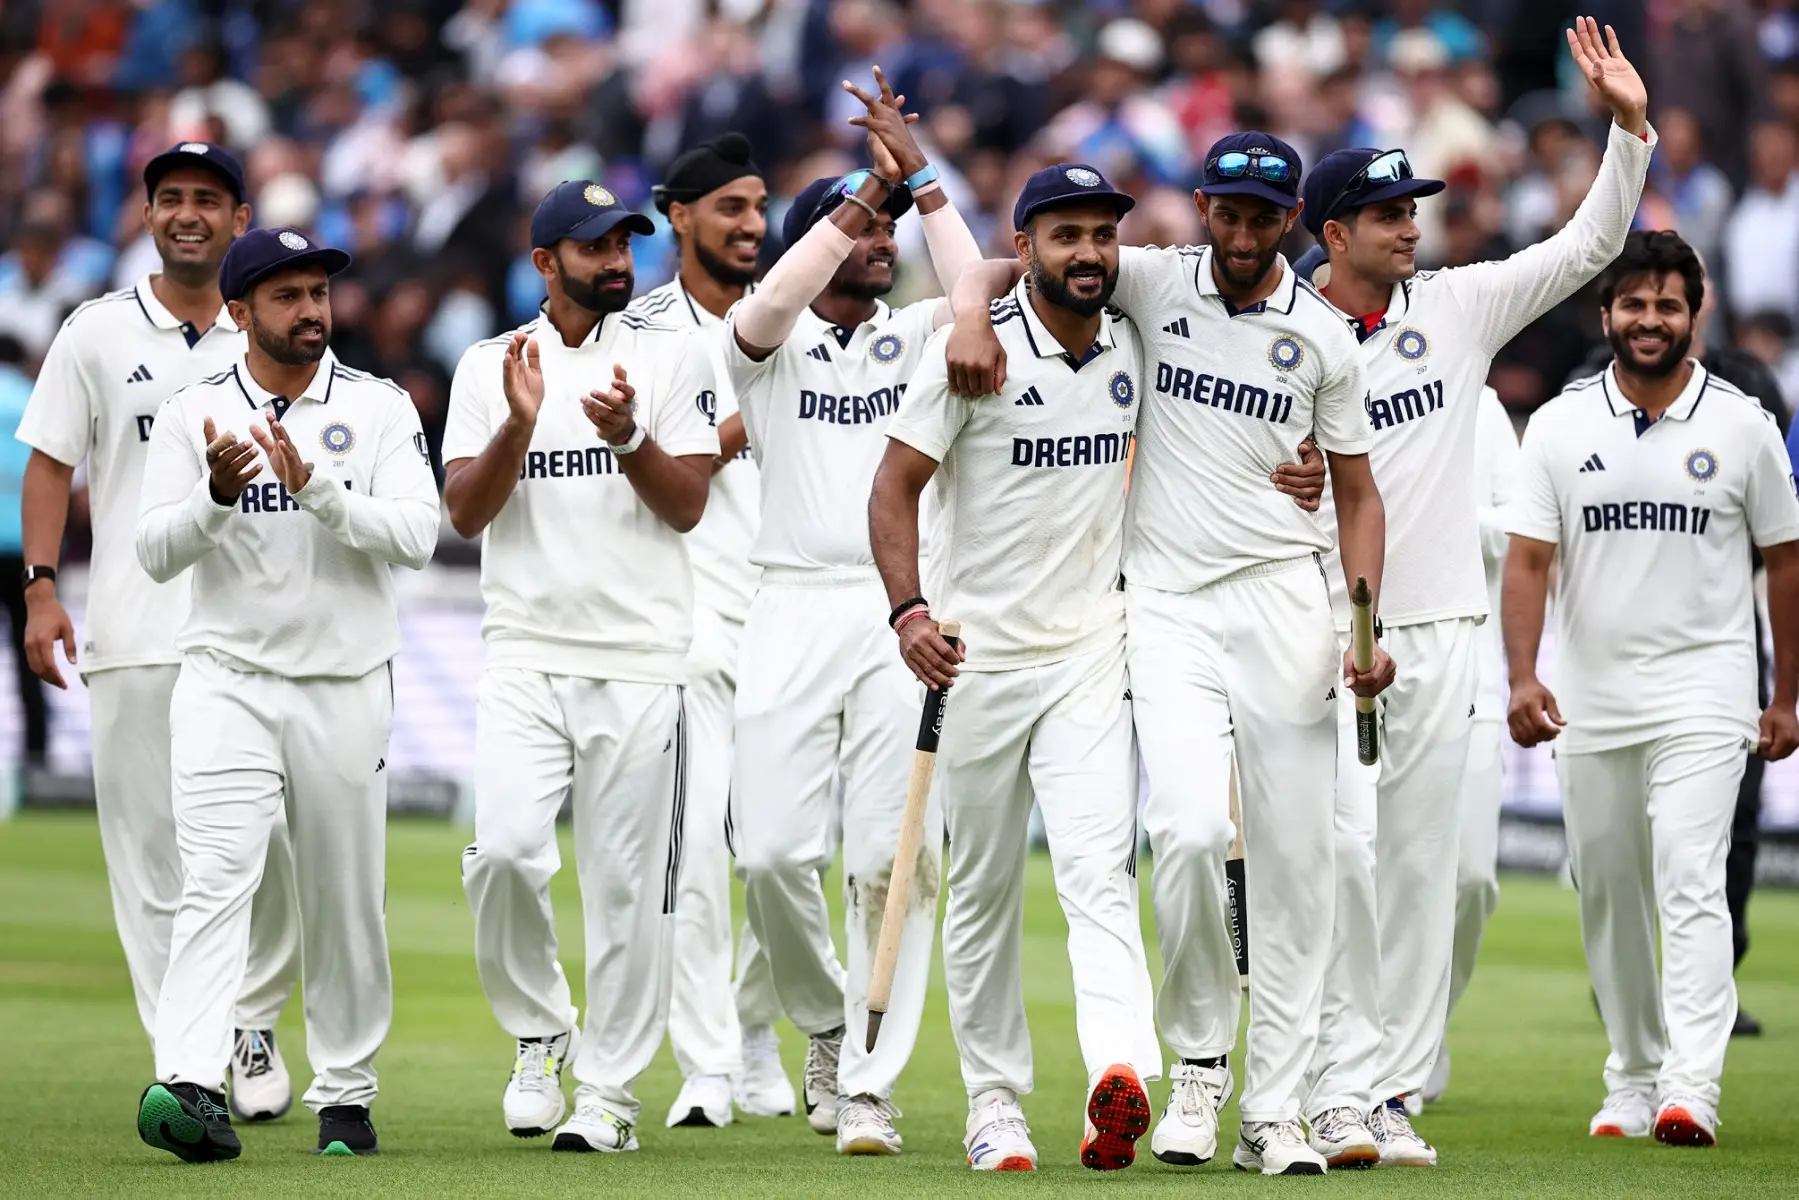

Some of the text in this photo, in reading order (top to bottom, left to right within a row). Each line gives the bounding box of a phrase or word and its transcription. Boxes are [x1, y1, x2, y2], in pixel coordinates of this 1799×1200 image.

[1155, 361, 1293, 424] DREAM11
[1371, 380, 1444, 431] AM11
[519, 446, 625, 480] REAM
[1582, 501, 1711, 535] DREAM11
